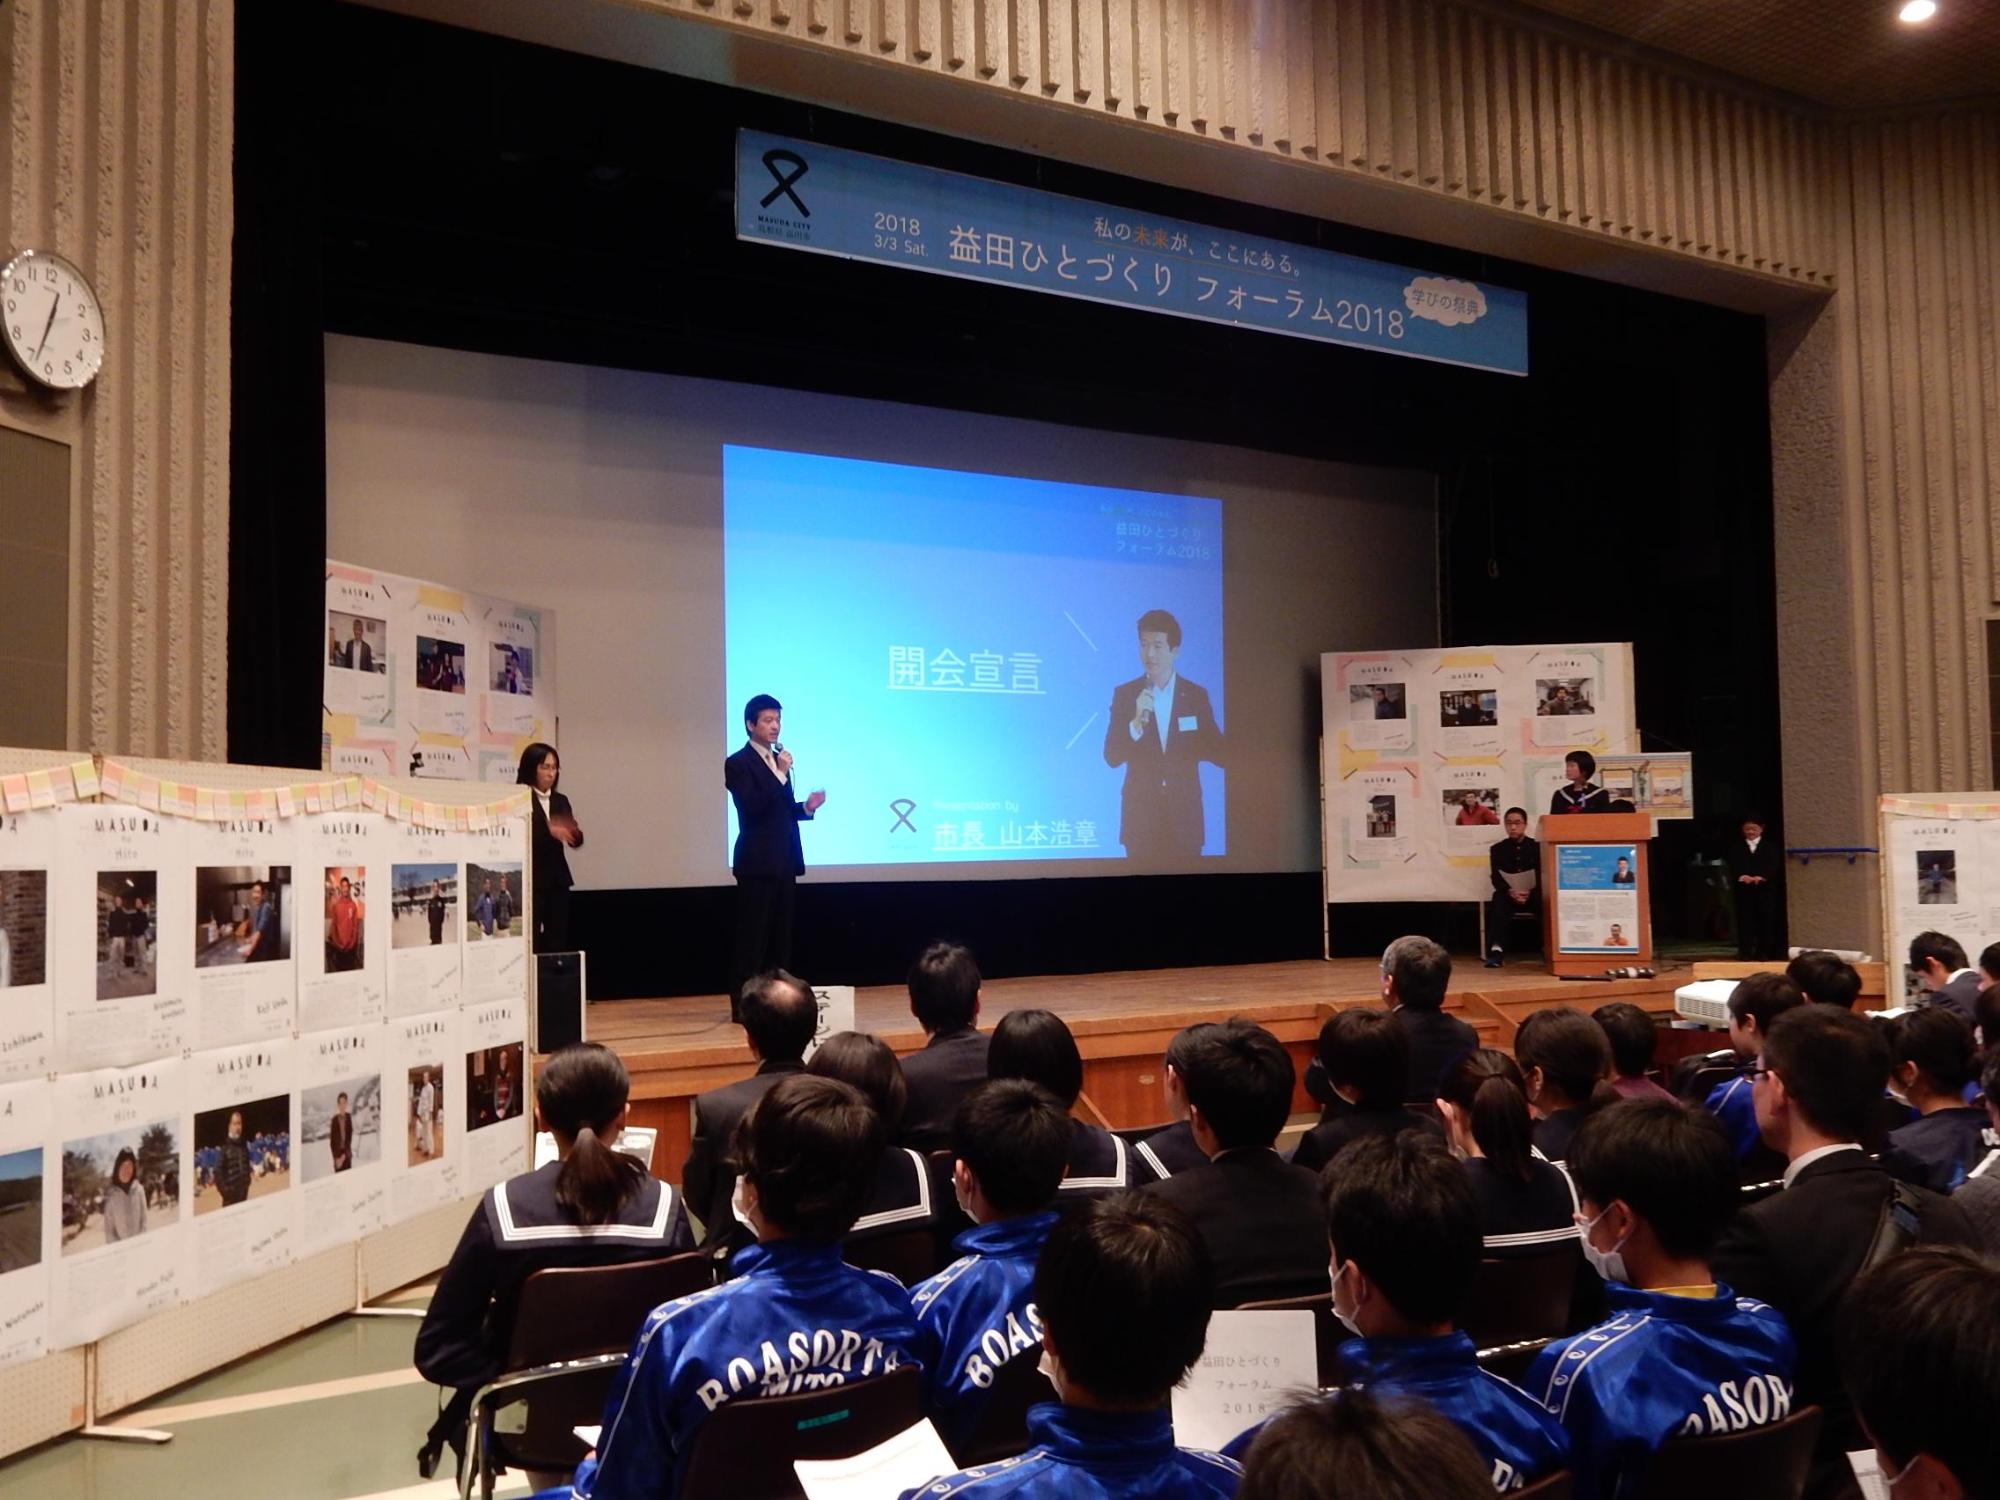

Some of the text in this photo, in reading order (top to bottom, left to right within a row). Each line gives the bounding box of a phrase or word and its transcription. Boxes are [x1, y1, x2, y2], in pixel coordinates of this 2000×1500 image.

[874, 211, 921, 237] 2018
[874, 233, 929, 257] 3/3 Sat.
[1094, 216, 1301, 278] 私の未来が、ここにある。
[29, 266, 37, 281] 11
[46, 267, 58, 284] 12
[949, 224, 1405, 339] 益田ひとづくり フォーラム2018
[13, 278, 26, 295] 10
[67, 282, 73, 297] 1
[7, 298, 17, 315] 9
[1411, 287, 1479, 317] 学びの祭典
[78, 303, 87, 319] 2
[12, 325, 22, 341] 8
[81, 328, 92, 343] 3
[75, 348, 84, 363] 4
[44, 360, 54, 376] 6
[63, 360, 73, 376] 5
[888, 644, 1043, 691] 開会宣言
[95, 817, 160, 836] MASUDA
[934, 818, 1097, 848] 市長 山本浩章
[216, 1052, 272, 1075] MASUDA
[94, 1074, 159, 1100] MASUDA
[1215, 1380, 1271, 1391] フォーラム
[1222, 1402, 1267, 1414] 2018
